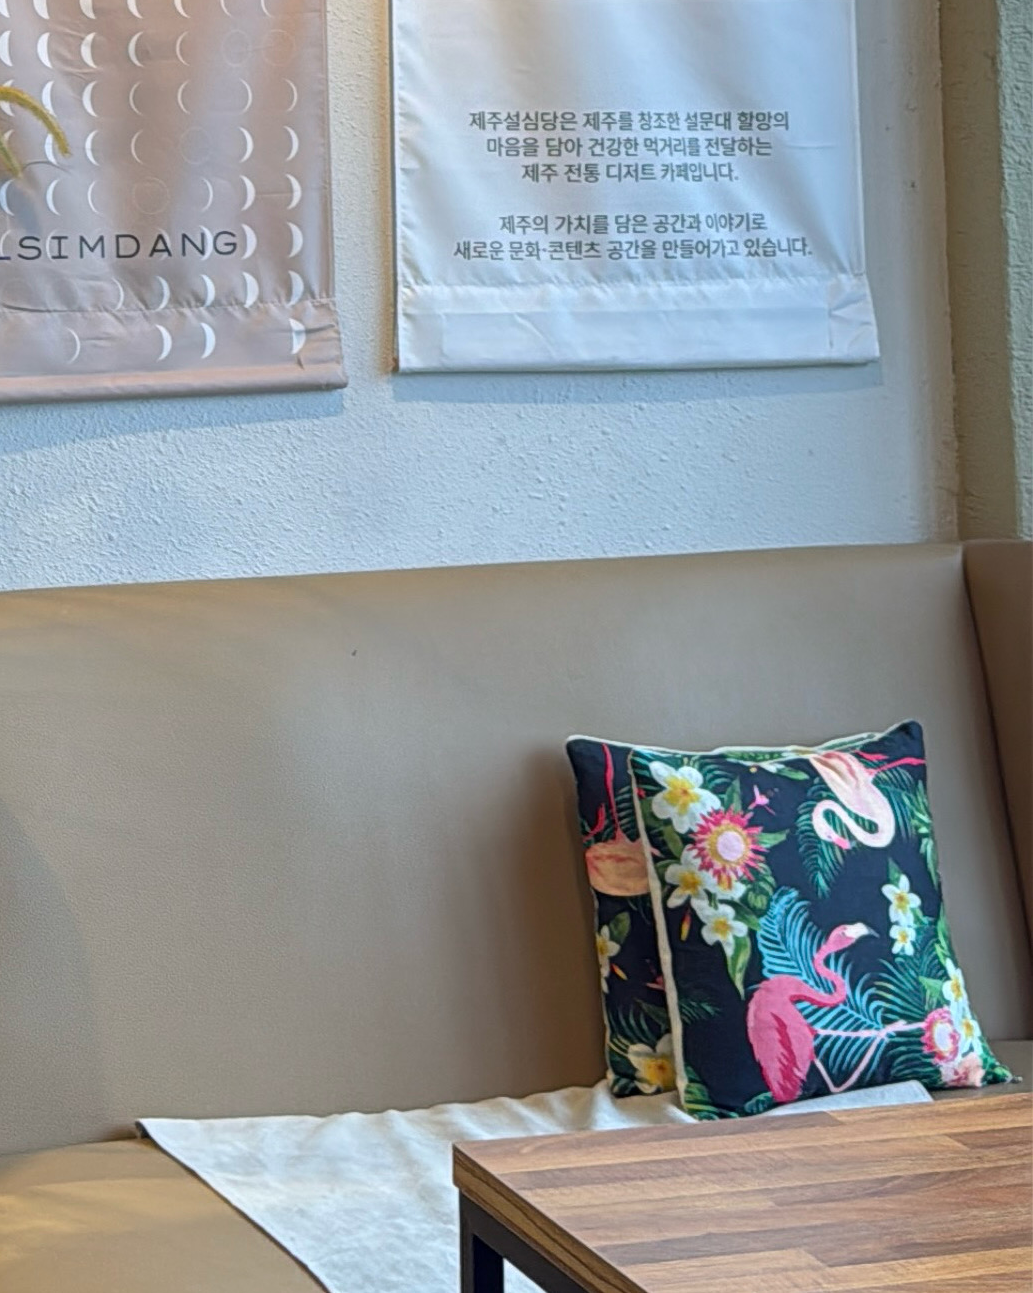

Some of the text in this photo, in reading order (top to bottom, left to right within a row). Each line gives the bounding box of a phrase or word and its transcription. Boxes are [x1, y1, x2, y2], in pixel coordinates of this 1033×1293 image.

[469, 110, 790, 131] 제주설심당은 제주를 창조한 설문대 할망의
[486, 136, 773, 157] 마음을 담아 건강한 먹거리를 전달하는
[521, 162, 739, 183] 제주 전통 디저트 카페입니다.
[498, 212, 768, 234] 제주의 가치를 담은 공간과 이야기로
[453, 240, 504, 260] 새로운
[607, 239, 657, 259] 공간을
[662, 238, 740, 258] 만들어가고
[743, 237, 813, 257] 있습니다.
